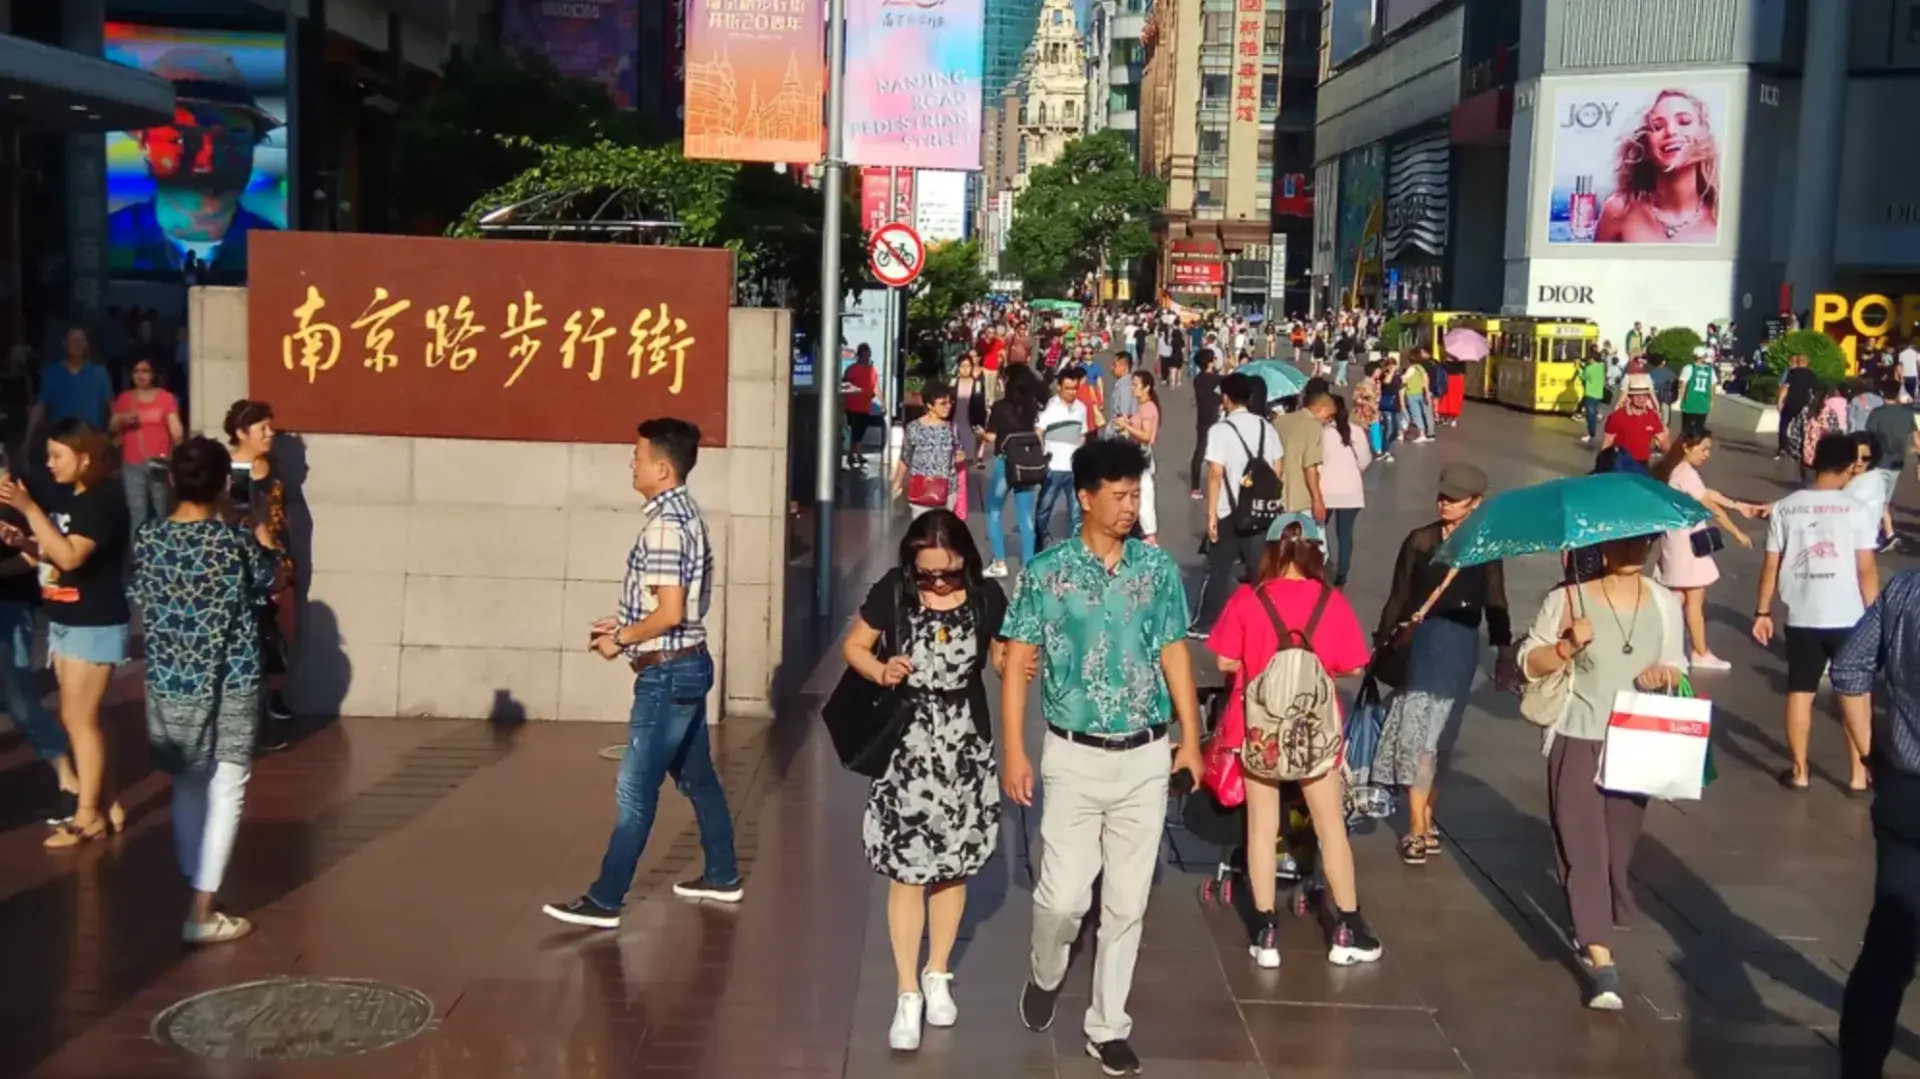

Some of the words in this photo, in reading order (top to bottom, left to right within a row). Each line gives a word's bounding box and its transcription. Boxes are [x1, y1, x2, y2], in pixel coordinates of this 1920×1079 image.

[876, 69, 965, 94] NANJING
[912, 91, 967, 109] ROAD
[851, 110, 970, 137] PEDESTRIAN
[1560, 101, 1619, 128] JOY
[902, 131, 970, 151] STREET
[1538, 285, 1595, 304] DIOR
[283, 285, 696, 394] 南京路步行街
